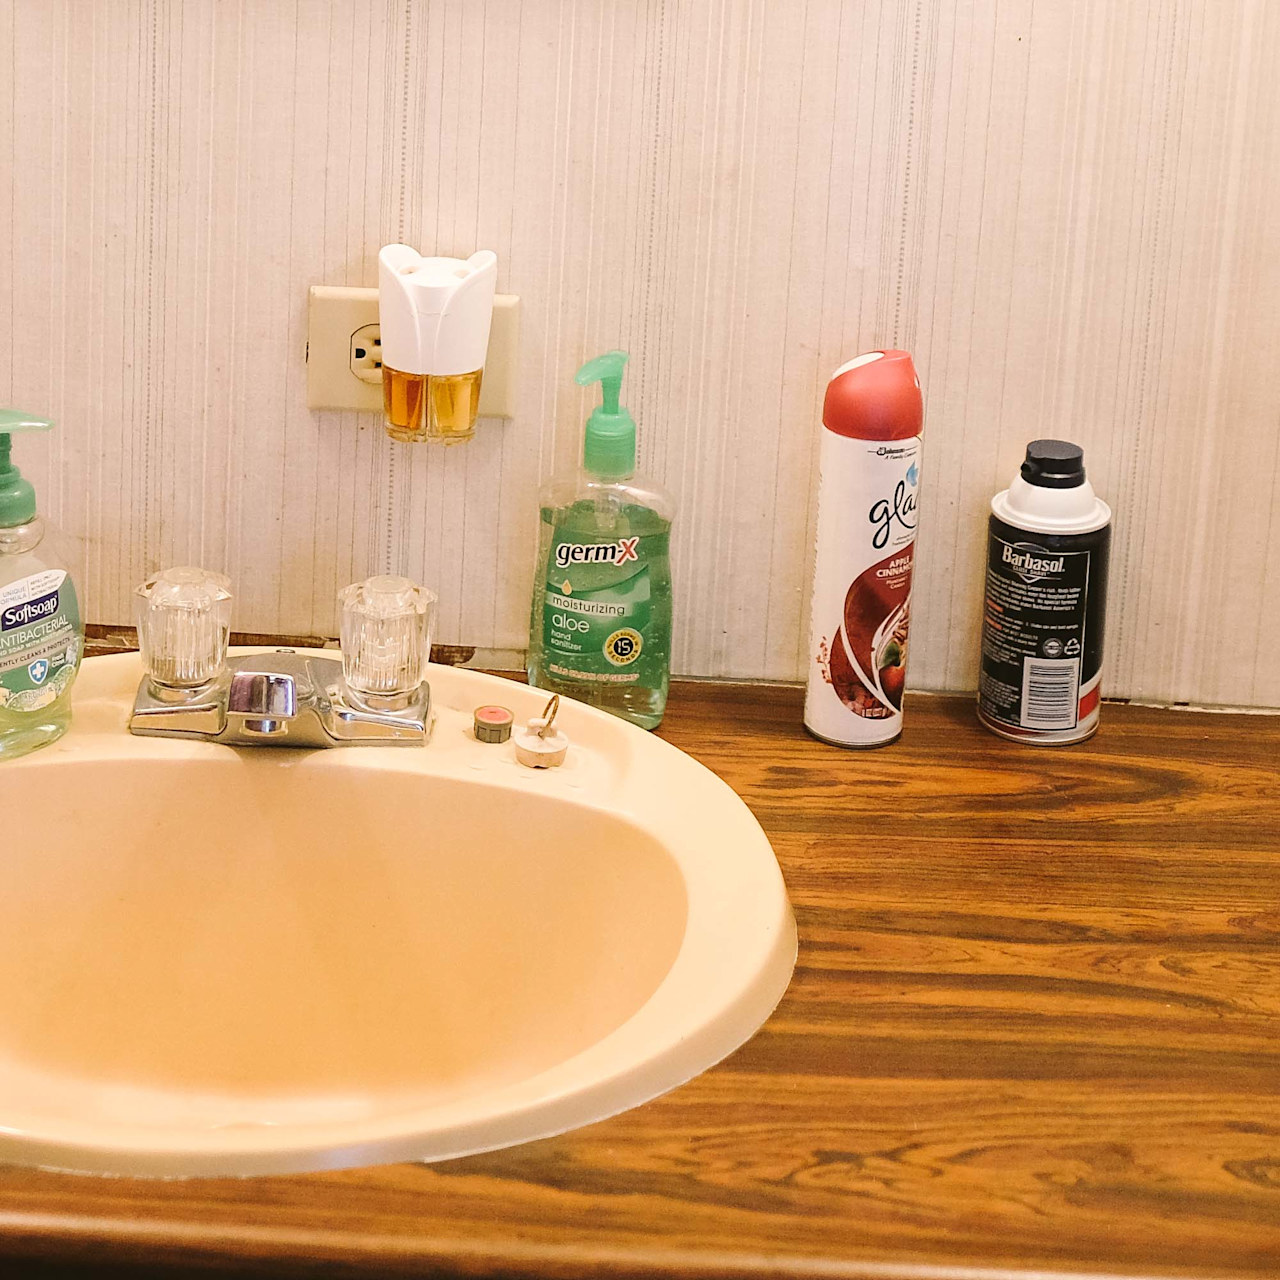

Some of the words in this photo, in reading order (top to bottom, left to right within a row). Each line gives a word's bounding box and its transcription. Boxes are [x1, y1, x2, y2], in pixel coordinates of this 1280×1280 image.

[869, 480, 917, 549] gla
[556, 537, 639, 567] germ-X
[1002, 545, 1065, 573] Barbasol
[2, 587, 26, 597] UNIQUE
[4, 598, 57, 625] Softsoap
[552, 596, 625, 617] moisturizing
[552, 613, 590, 633] aloe
[550, 638, 582, 651] sanitizer
[551, 629, 571, 640] hand
[8, 644, 25, 653] SOAP
[20, 650, 41, 662] CLEANS
[47, 637, 71, 651] PROTECTS
[616, 640, 631, 654] 15
